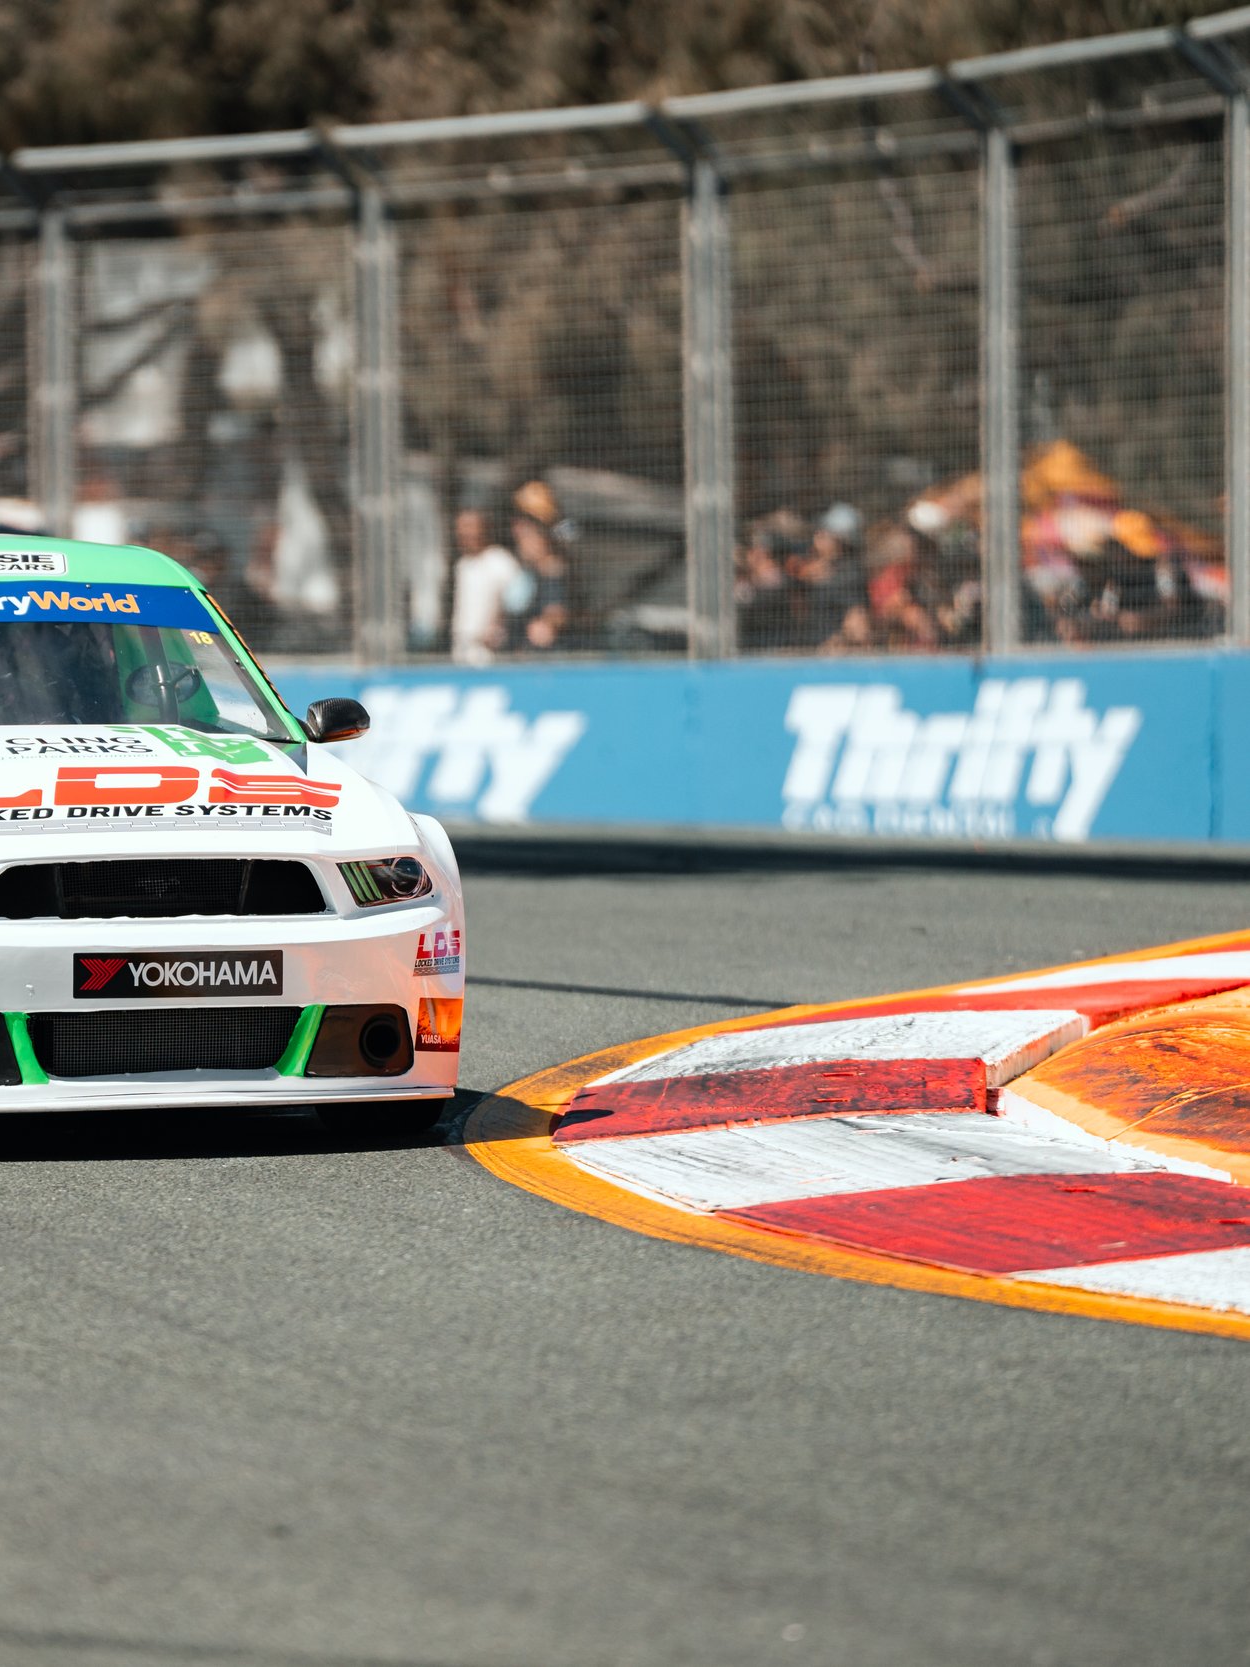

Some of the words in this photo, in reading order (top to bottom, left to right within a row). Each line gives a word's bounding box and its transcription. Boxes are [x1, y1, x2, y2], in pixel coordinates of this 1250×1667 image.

[189, 631, 214, 645] 18
[5, 745, 154, 755] PARKS
[781, 677, 1143, 842] Thrifty
[66, 805, 165, 818] DRIVE
[174, 805, 333, 821] SYSTEMS
[416, 929, 461, 959] LDS
[414, 959, 433, 968] LOCKED
[127, 960, 278, 987] YOKOHAMA
[420, 1034, 442, 1045] YUASA
